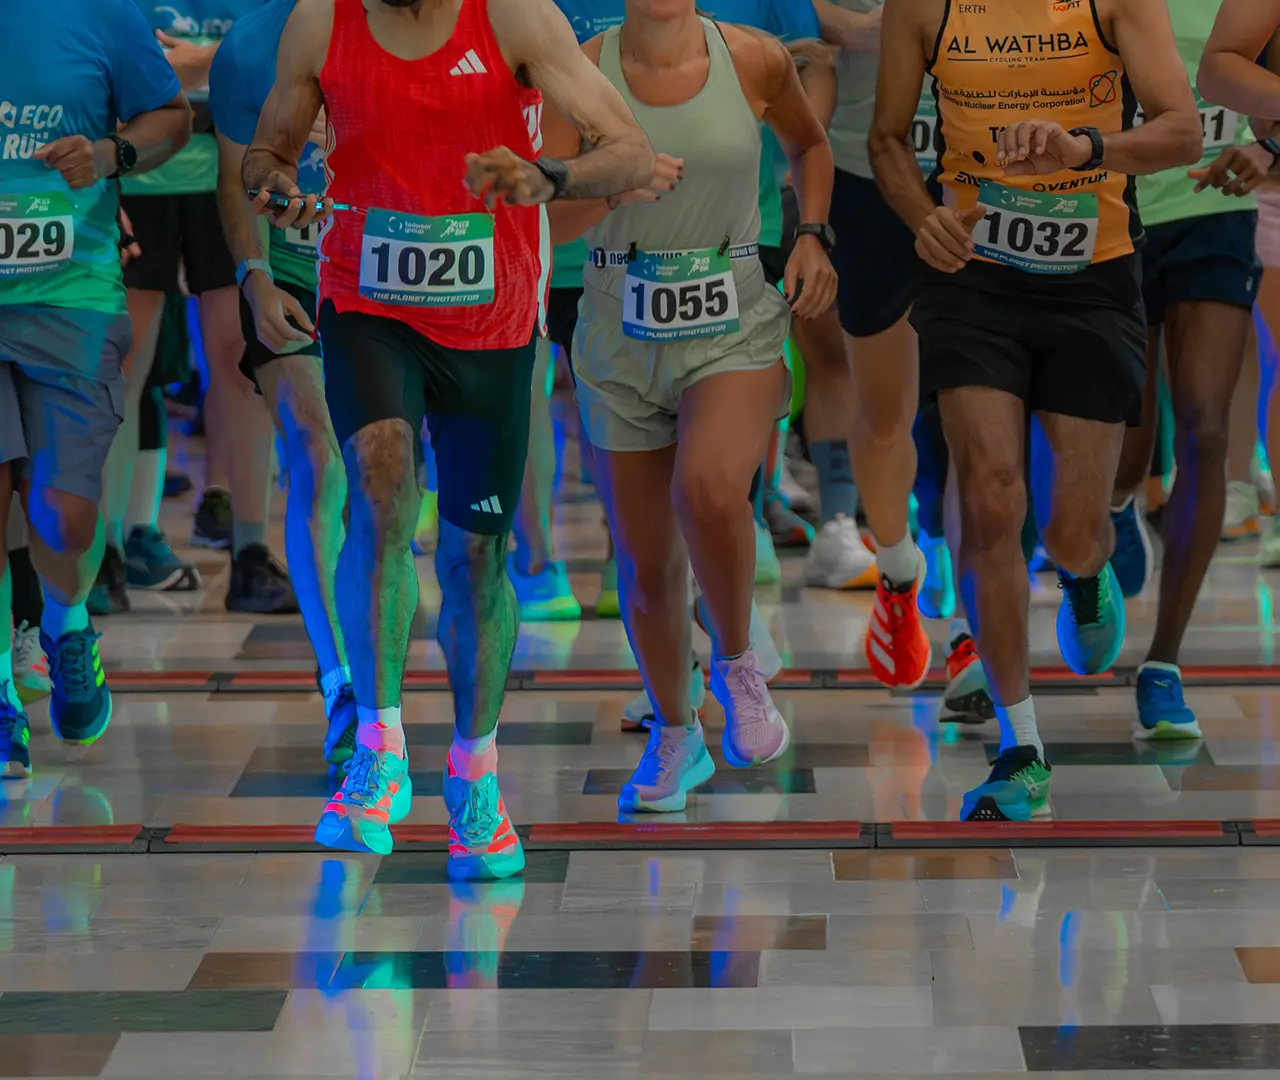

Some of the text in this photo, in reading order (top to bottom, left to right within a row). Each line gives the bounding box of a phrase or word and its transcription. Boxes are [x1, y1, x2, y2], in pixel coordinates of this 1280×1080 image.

[959, 4, 986, 14] ERTH
[947, 31, 1089, 54] AL WATHBA
[965, 100, 995, 110] Nuclear
[998, 101, 1030, 111] Energy
[1032, 97, 1085, 109] Corporation
[20, 105, 63, 129] ECO
[984, 211, 1089, 257] 1032
[371, 242, 485, 286] 1020
[983, 250, 998, 258] THE
[373, 291, 480, 303] THE PLANET PROTECTOR
[631, 279, 729, 324] 1055
